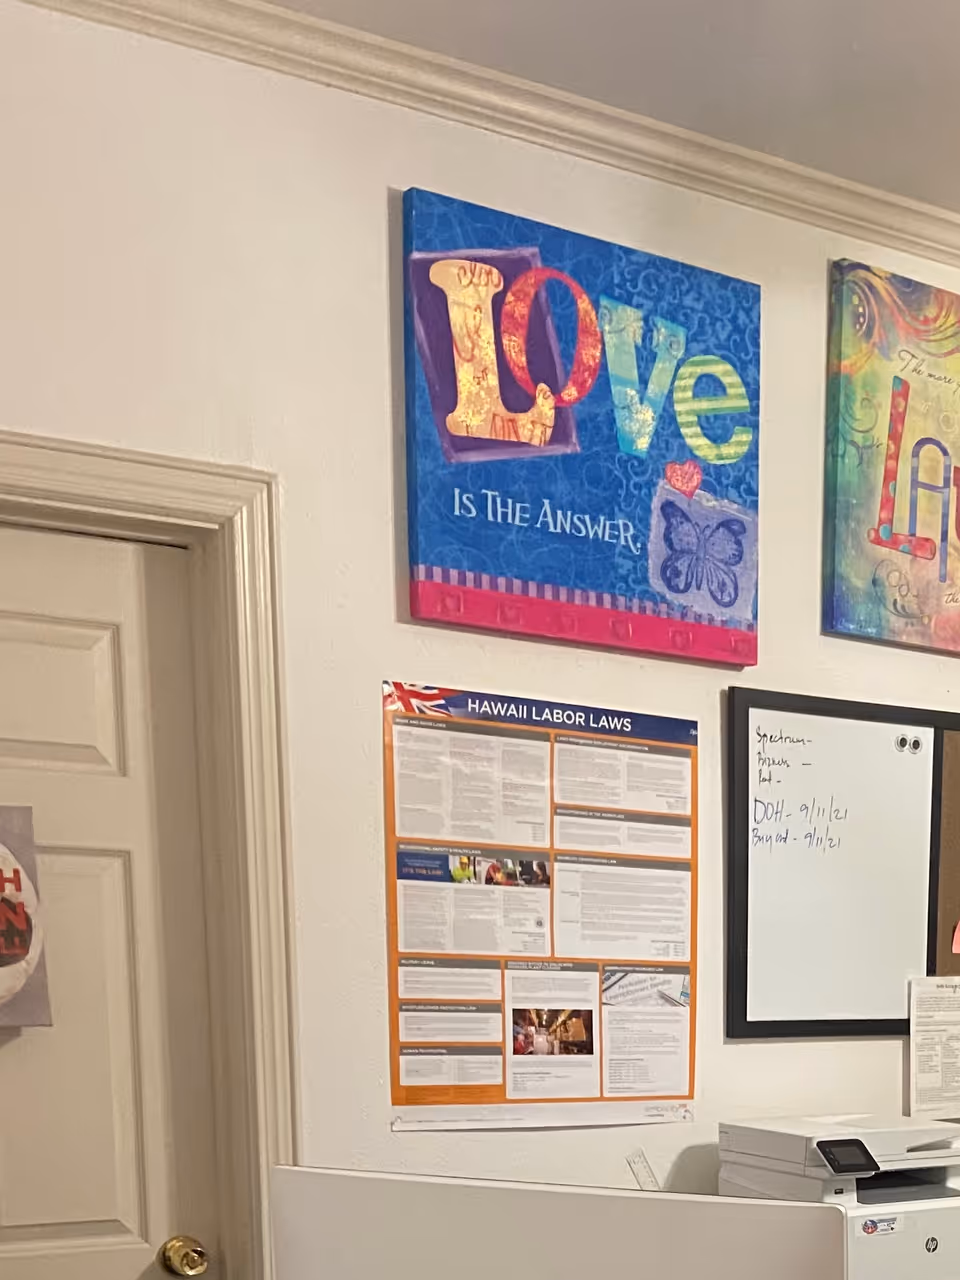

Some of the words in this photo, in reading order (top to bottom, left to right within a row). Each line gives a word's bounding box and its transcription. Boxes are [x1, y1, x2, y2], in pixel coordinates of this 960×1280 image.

[481, 488, 531, 527] THE
[467, 698, 527, 719] HAWAII
[532, 705, 586, 727] LABOR
[589, 713, 632, 732] LAWS
